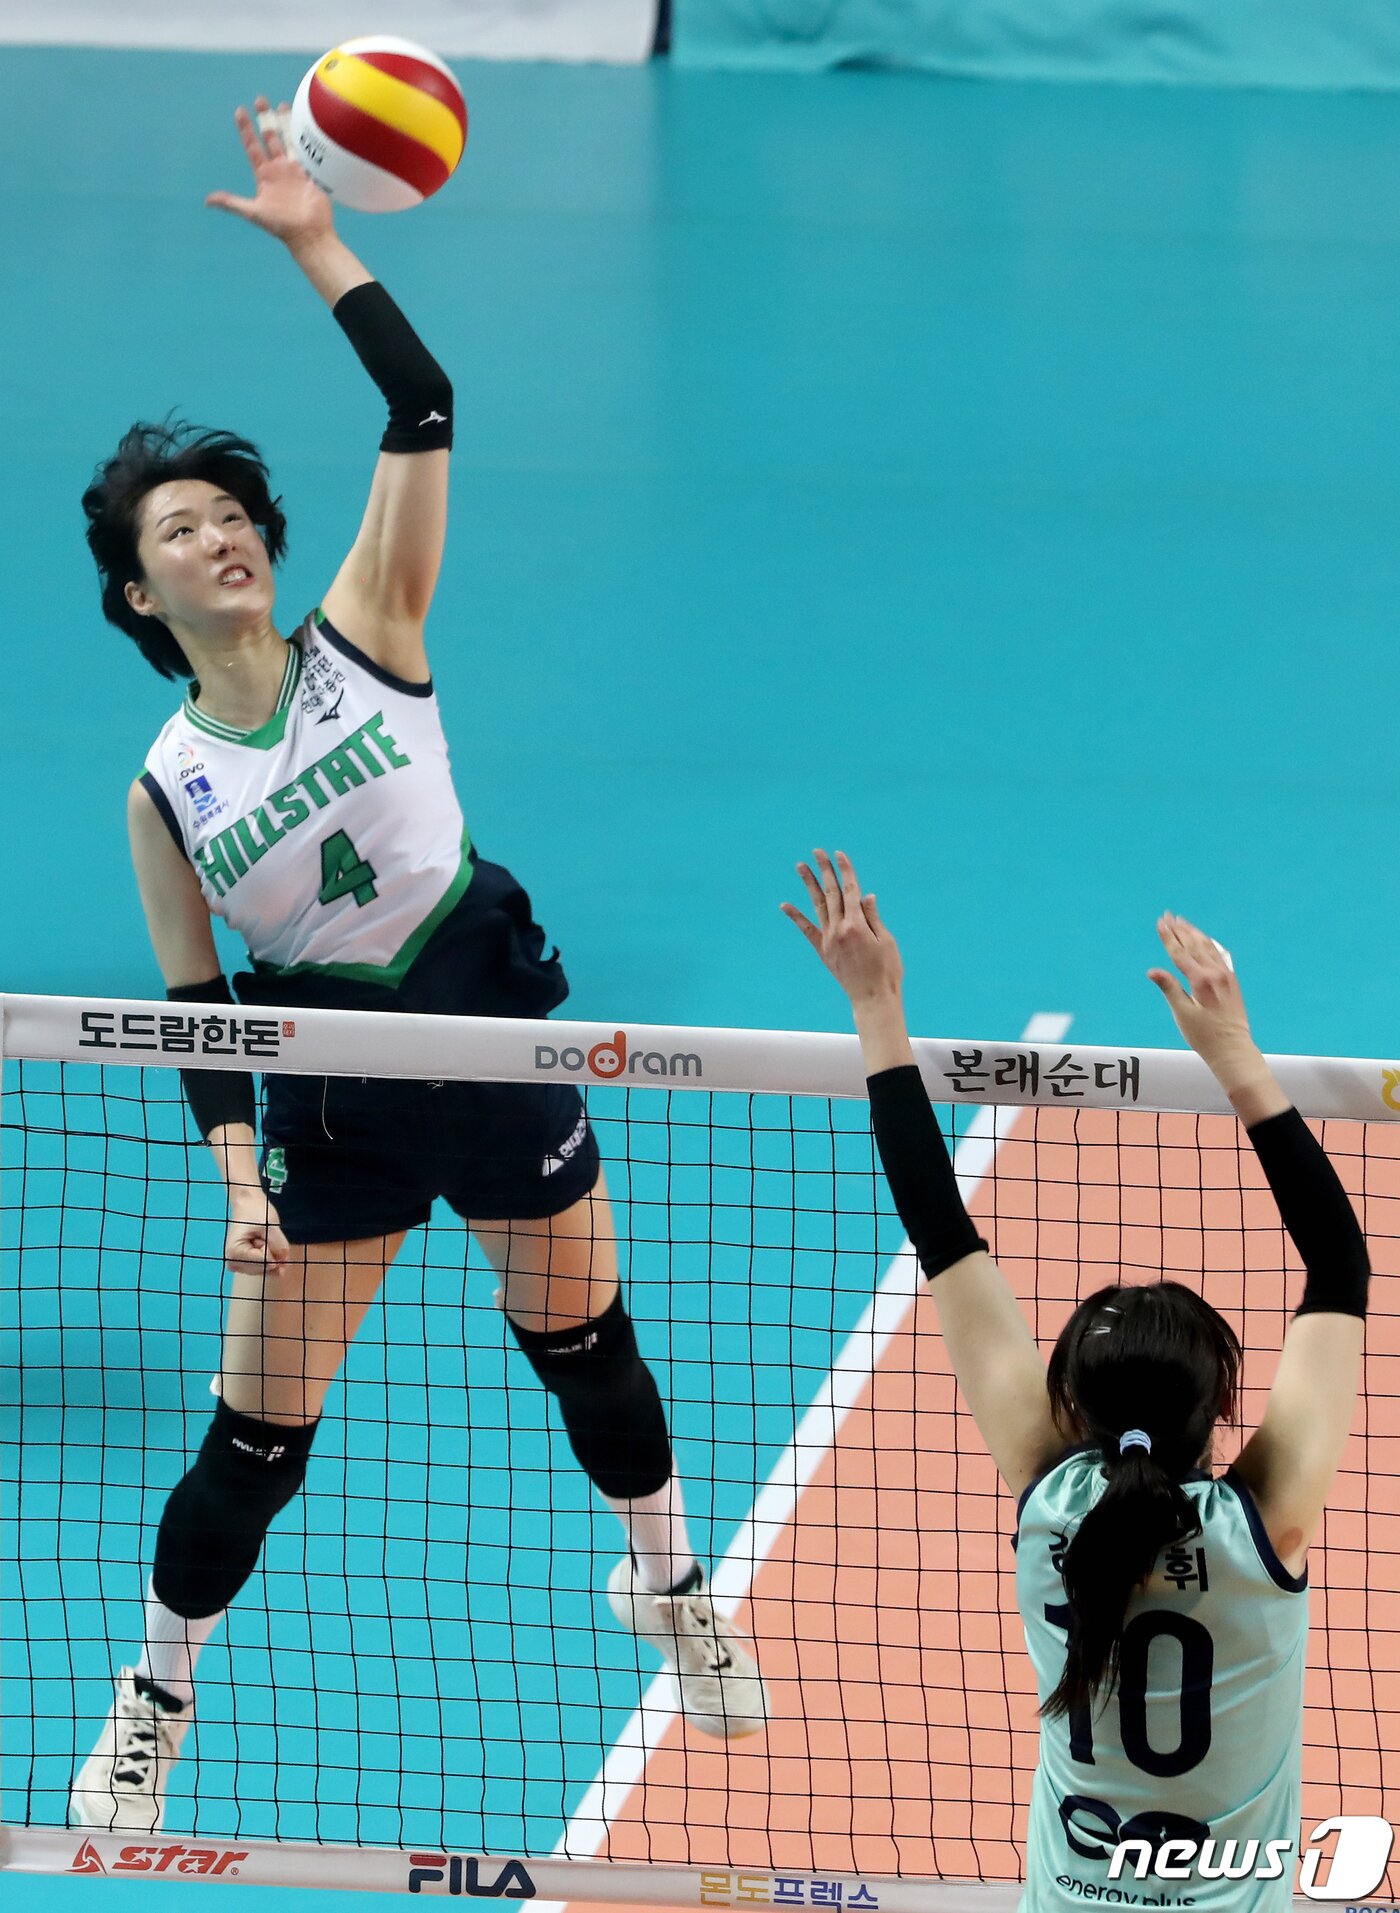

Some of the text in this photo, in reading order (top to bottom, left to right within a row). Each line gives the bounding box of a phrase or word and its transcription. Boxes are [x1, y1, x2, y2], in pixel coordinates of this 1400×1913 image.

[179, 763, 205, 781] OVO
[193, 710, 411, 898] HILLSTATE
[318, 828, 379, 908] 4
[79, 1012, 280, 1057] 도드람한돈
[943, 1048, 1140, 1101] 본래순대
[409, 1854, 537, 1899] FILA
[700, 1872, 879, 1913] 몬도프렉스
